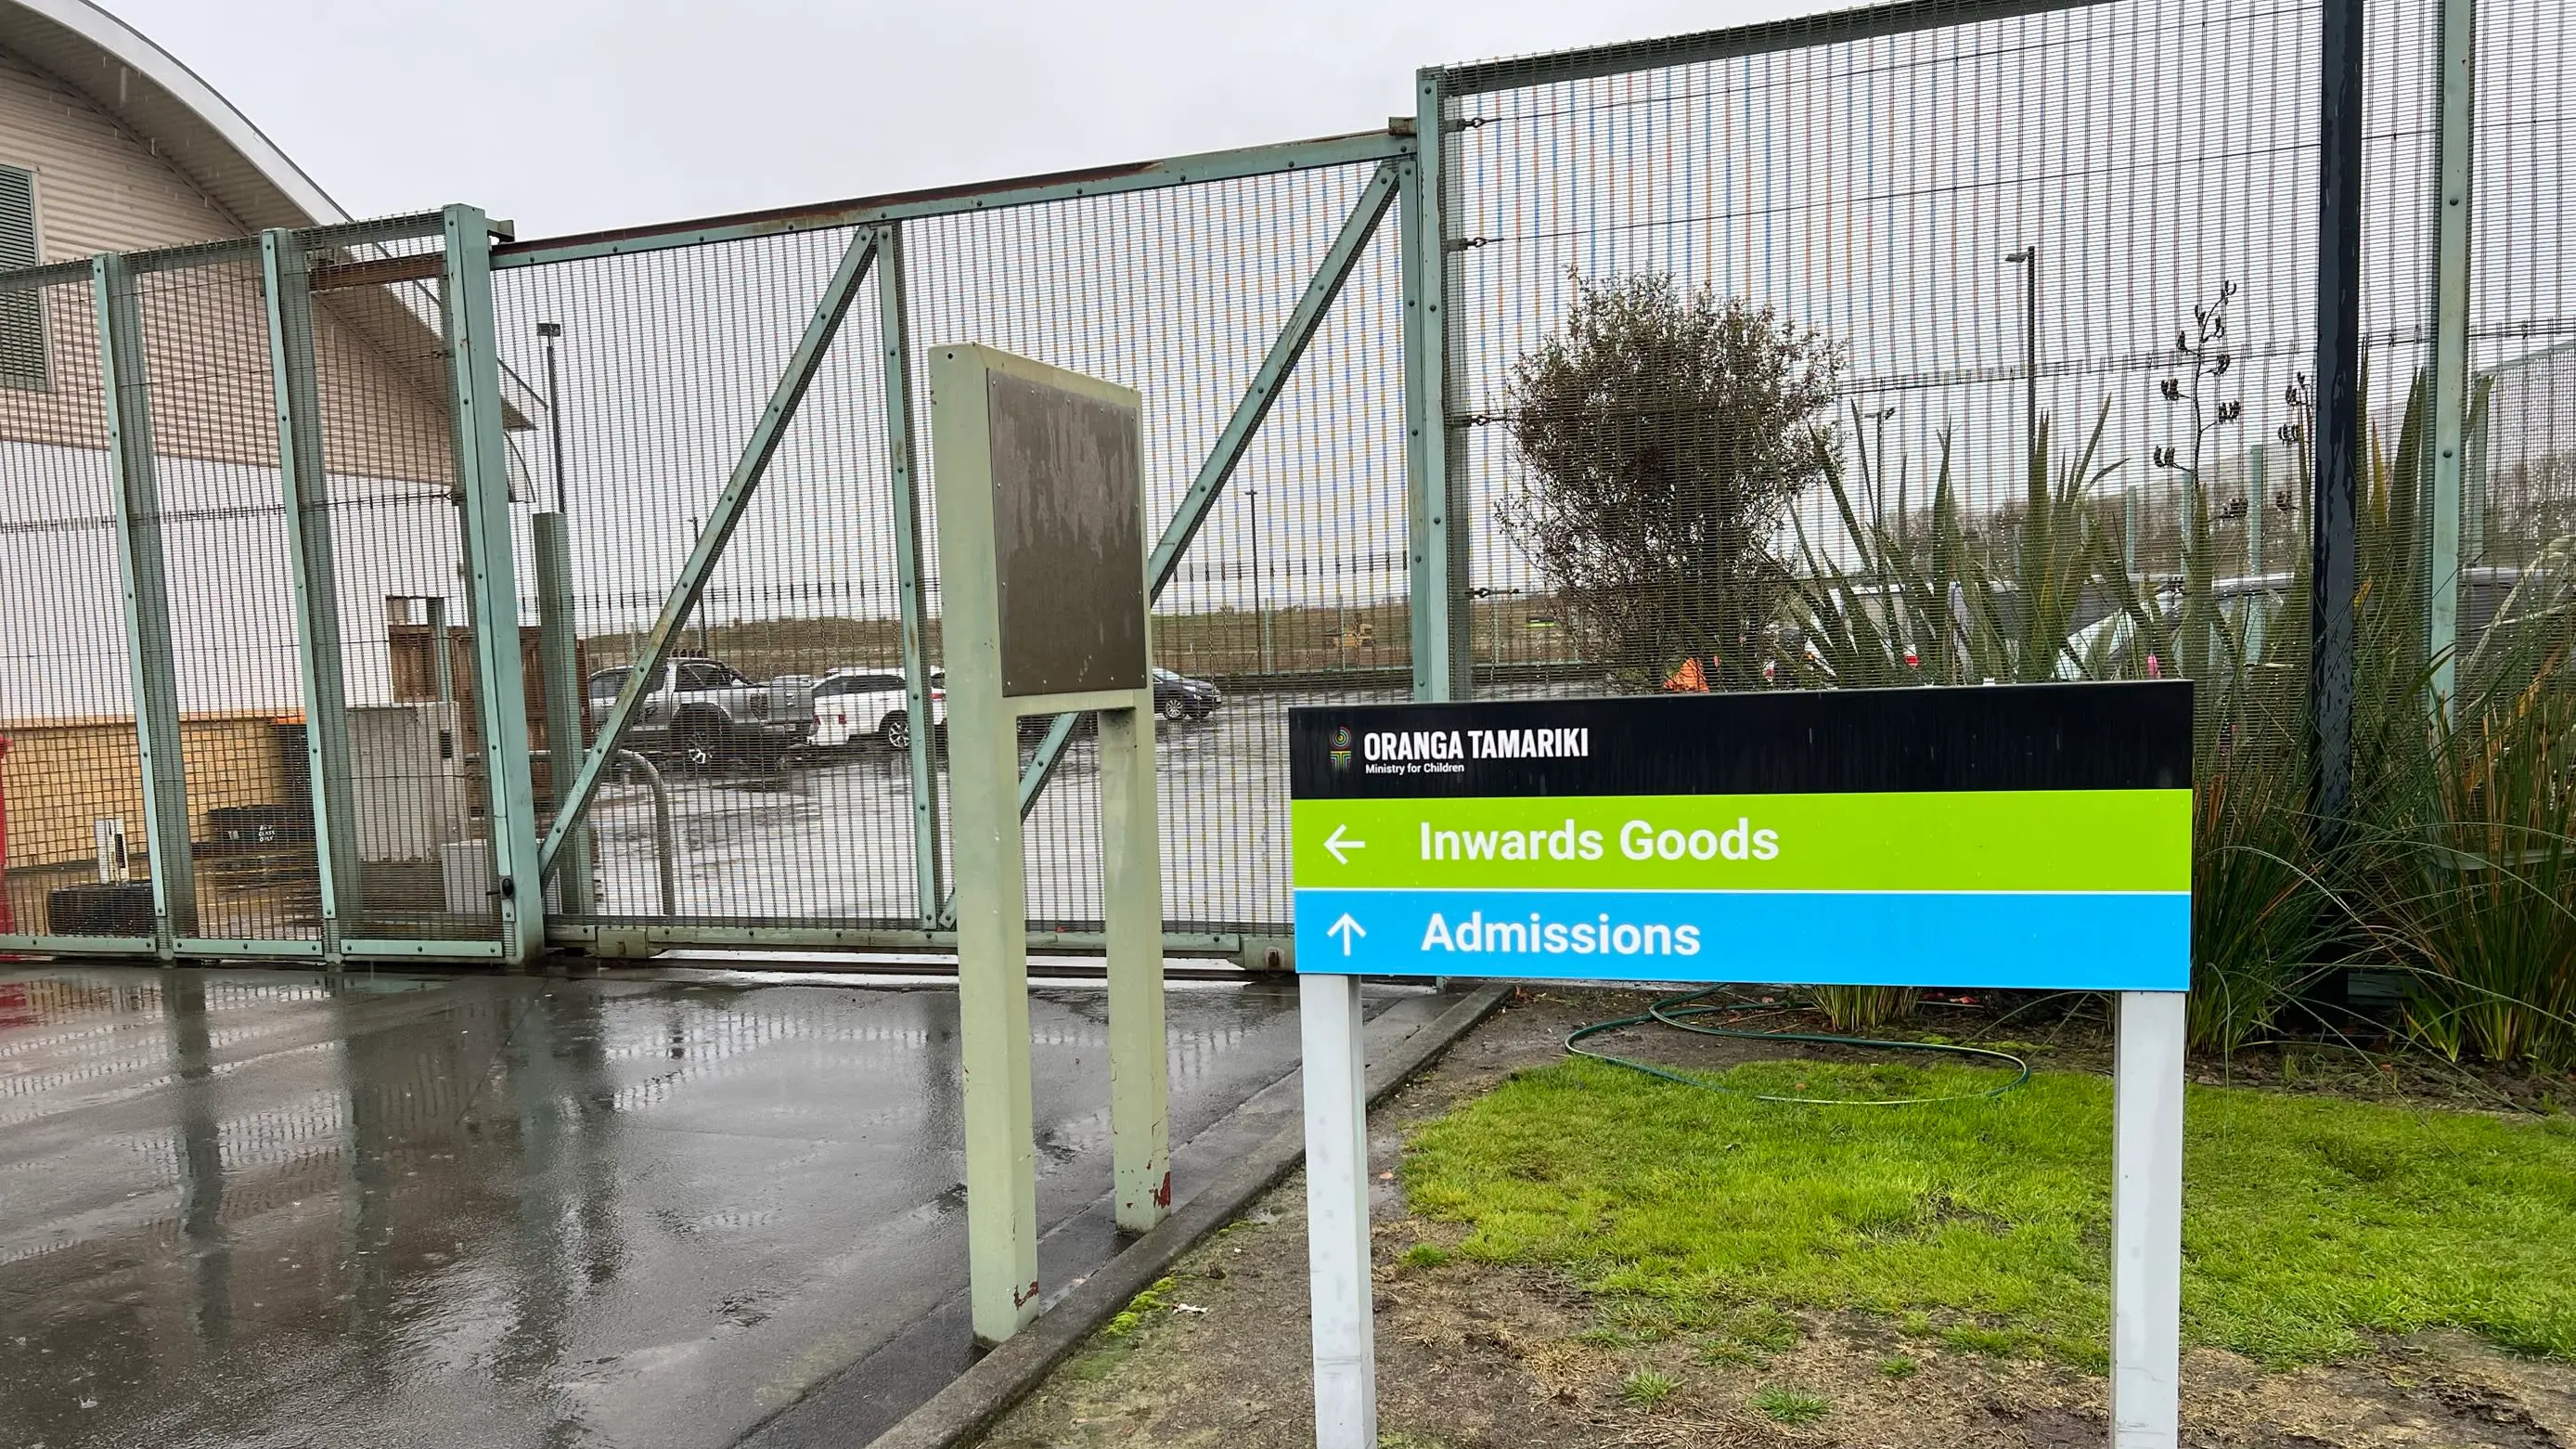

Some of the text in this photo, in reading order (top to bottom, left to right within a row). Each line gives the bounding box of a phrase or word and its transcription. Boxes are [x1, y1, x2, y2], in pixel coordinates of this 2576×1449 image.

[1363, 727, 1589, 761] ORANGA TAMARIKI
[1365, 762, 1465, 776] Ministry for Children
[1420, 817, 1781, 861] Inwards Goods
[1421, 911, 1702, 956] Admissions
